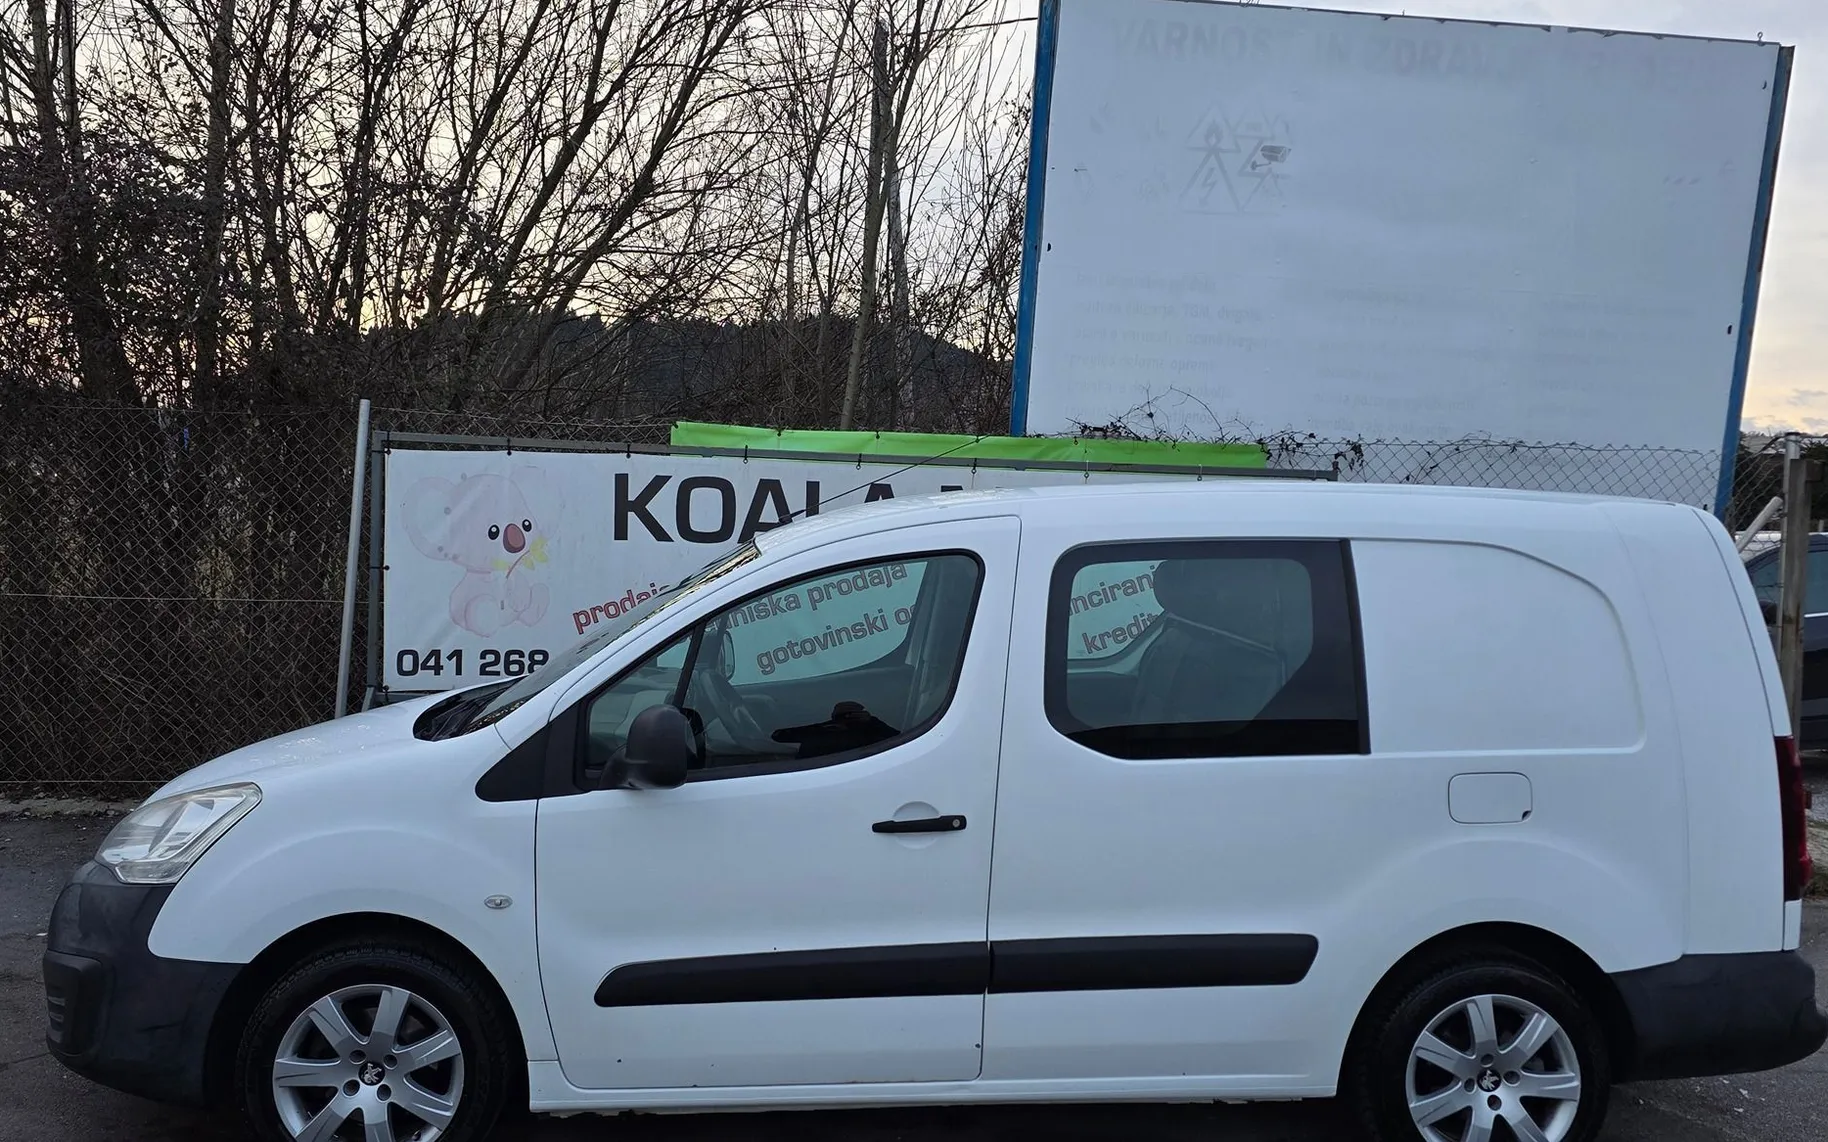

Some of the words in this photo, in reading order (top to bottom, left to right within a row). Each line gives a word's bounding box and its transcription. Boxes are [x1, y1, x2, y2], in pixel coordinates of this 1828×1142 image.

[807, 563, 908, 611] prodaja
[1069, 564, 1156, 616] nciran
[396, 649, 463, 677] 041
[478, 649, 550, 677] 268
[756, 608, 889, 676] gotovinski
